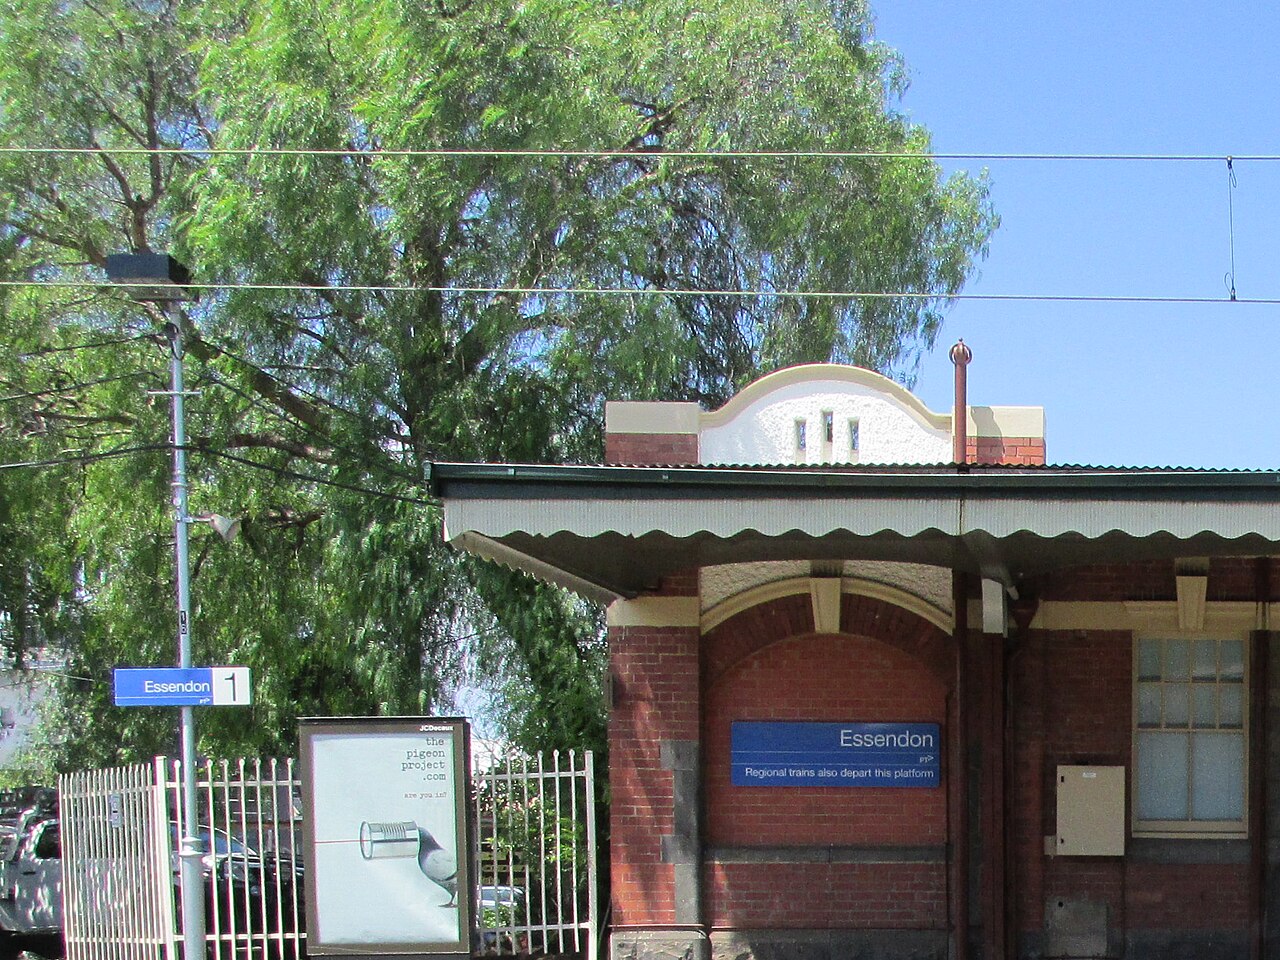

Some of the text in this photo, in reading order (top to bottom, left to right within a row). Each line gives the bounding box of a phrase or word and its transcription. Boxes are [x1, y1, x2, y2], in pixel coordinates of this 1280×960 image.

[144, 680, 210, 693] Essendon
[224, 672, 236, 702] 1
[426, 737, 445, 746] the
[840, 729, 933, 747] Essendon
[406, 749, 446, 760] pigeon
[401, 761, 446, 771] project
[422, 773, 446, 781] .com
[745, 767, 934, 780] Regional trains also depart this platform
[419, 792, 433, 800] you
